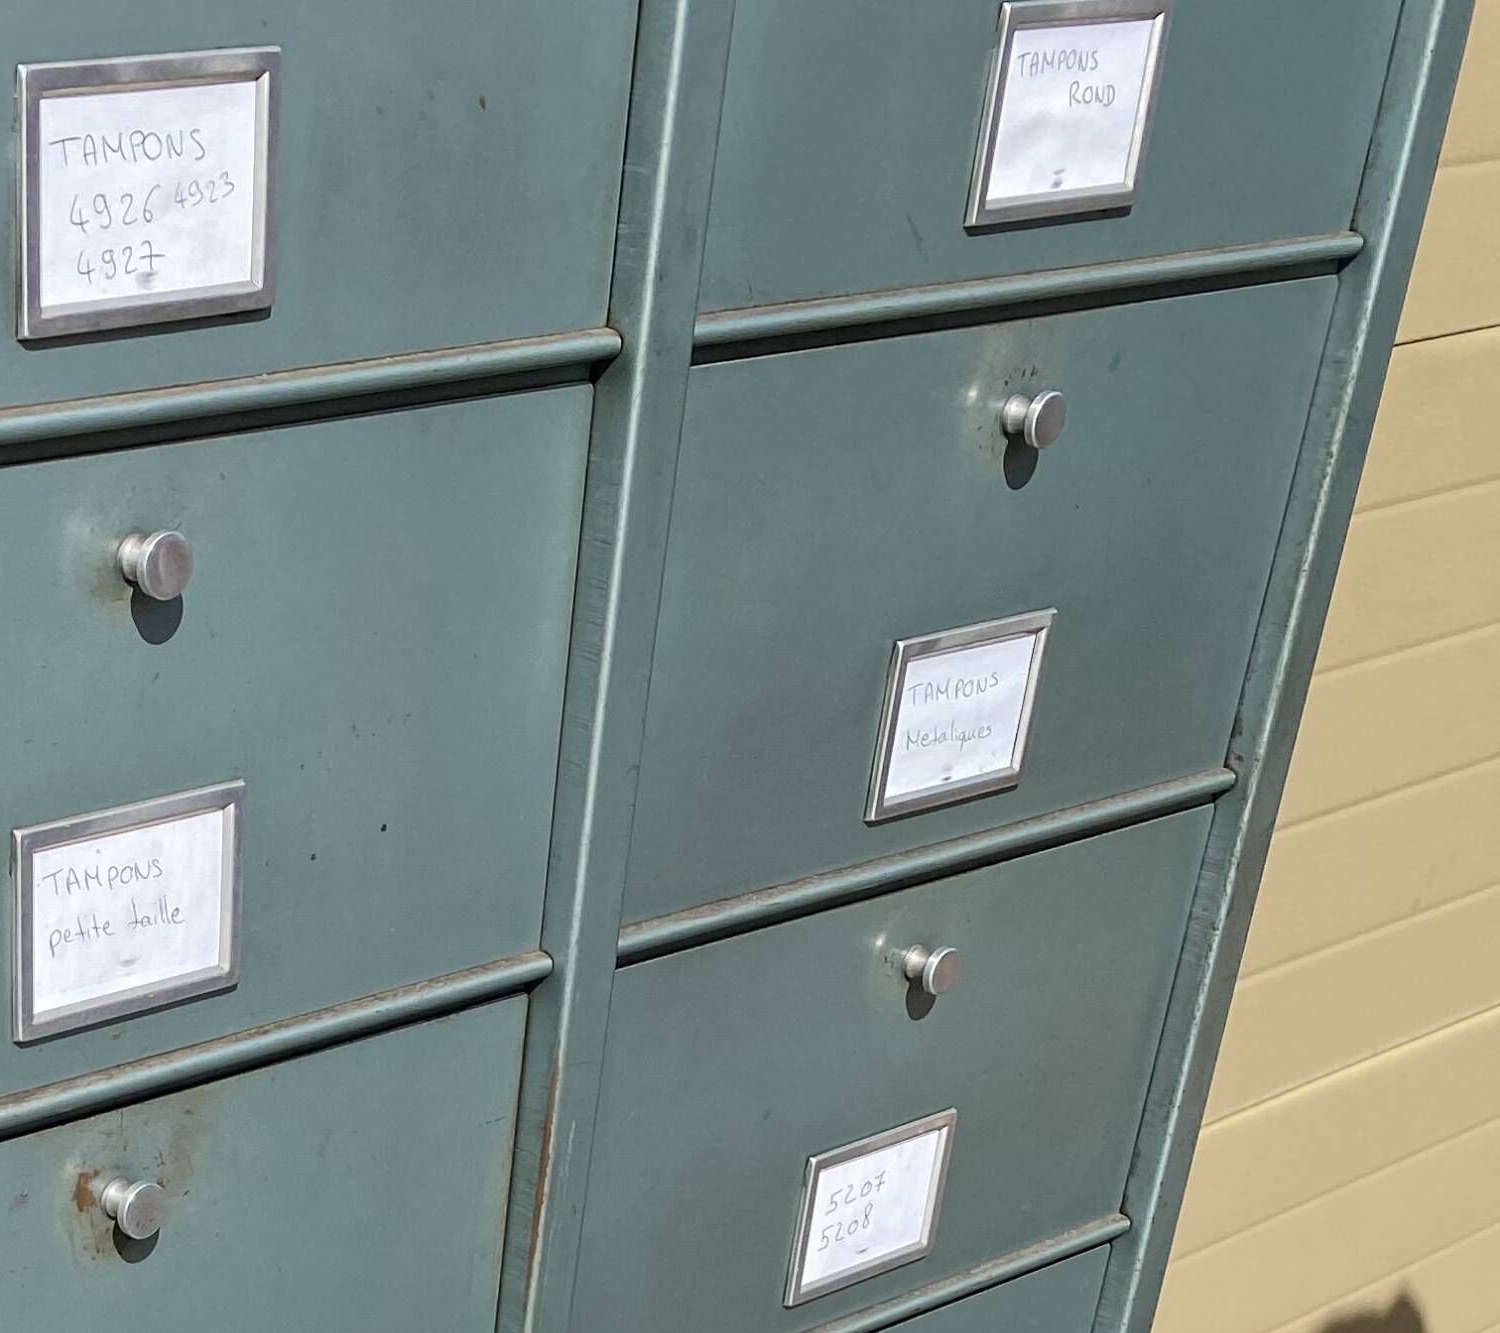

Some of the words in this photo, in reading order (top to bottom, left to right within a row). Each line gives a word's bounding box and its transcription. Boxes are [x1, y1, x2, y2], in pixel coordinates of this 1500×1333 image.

[1017, 49, 1099, 77] TAMPONS
[1068, 80, 1116, 107] ROND
[49, 128, 206, 166] TAMPONS
[70, 184, 161, 234] 4926
[174, 171, 235, 209] 4923
[77, 240, 165, 284] 4927
[908, 672, 999, 705] TAMPONS
[42, 858, 164, 896] TAMPONS
[48, 913, 115, 958] petite
[127, 895, 185, 929] taille
[825, 1170, 886, 1216] 5207
[817, 1202, 873, 1251] 5208
